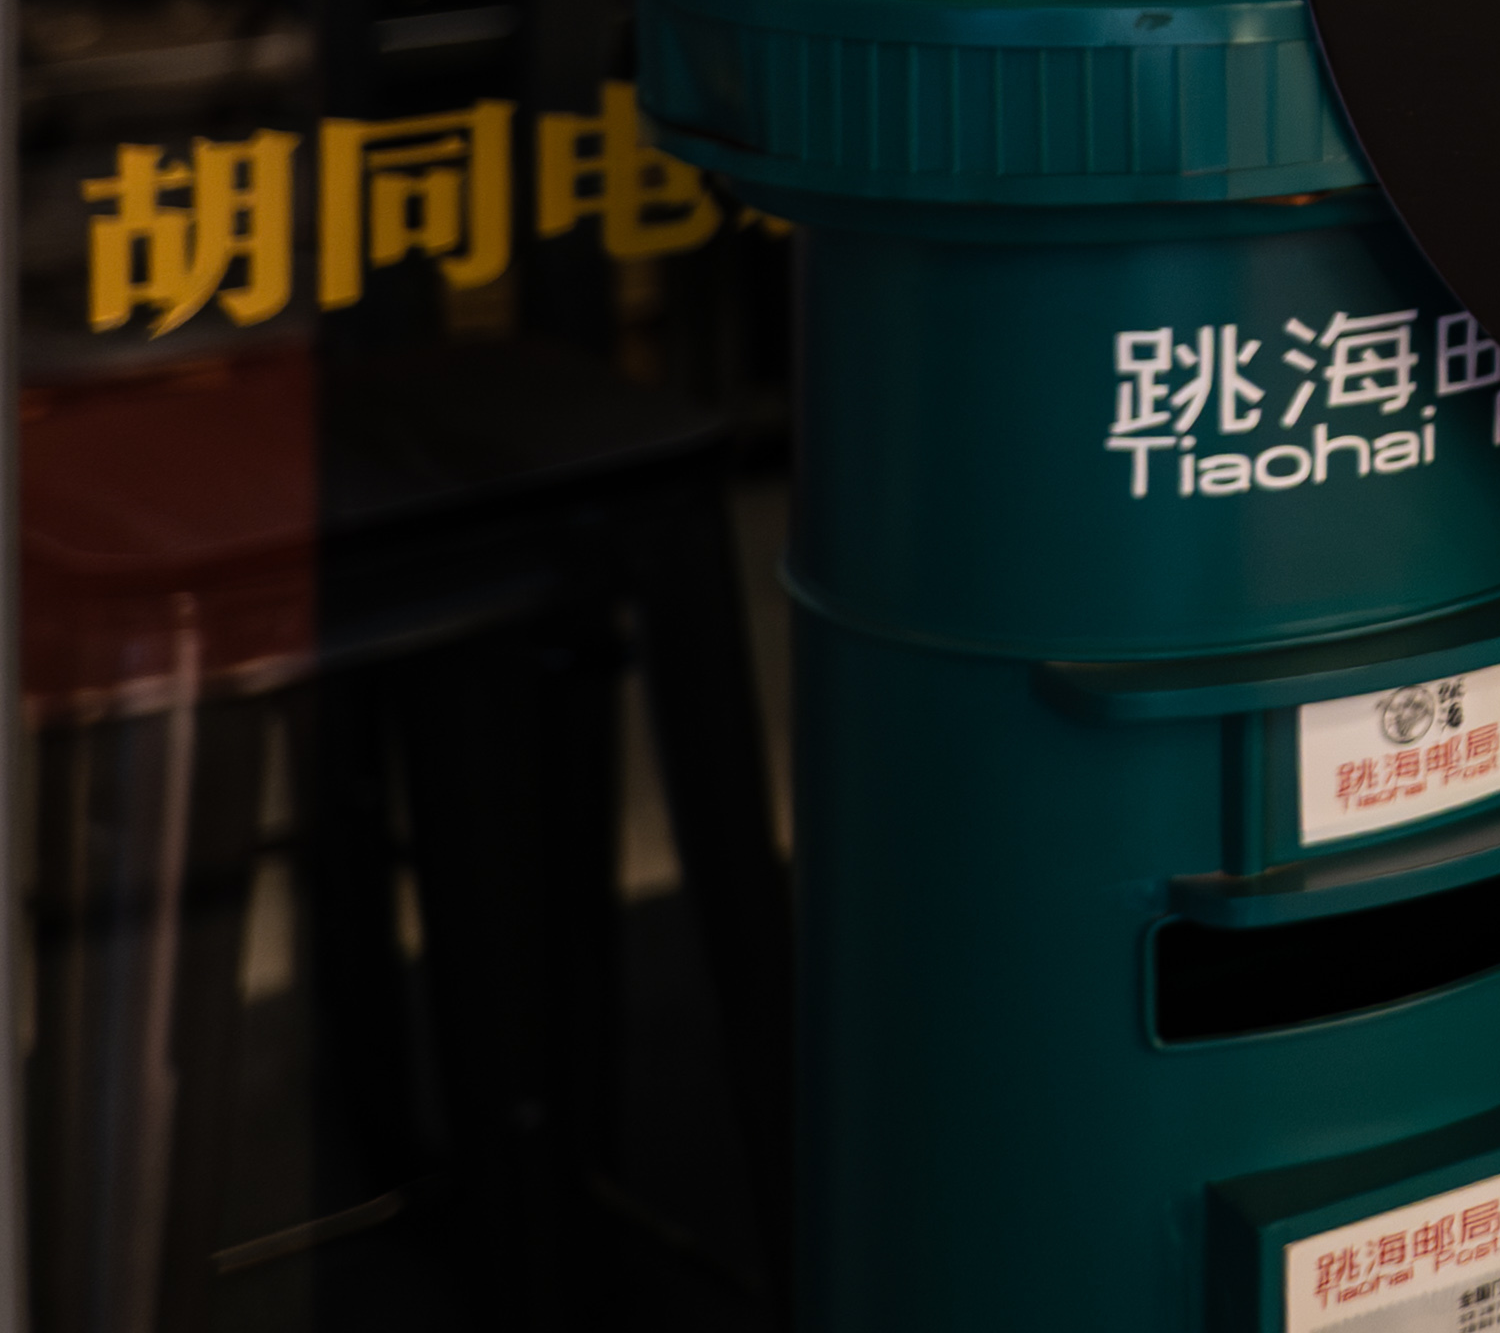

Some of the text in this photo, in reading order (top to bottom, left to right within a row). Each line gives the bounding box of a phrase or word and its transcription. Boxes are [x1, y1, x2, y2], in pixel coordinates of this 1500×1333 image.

[82, 79, 797, 339] 胡同电
[1104, 406, 1437, 499] Tiaohai
[1335, 721, 1500, 796] 跳海邮局
